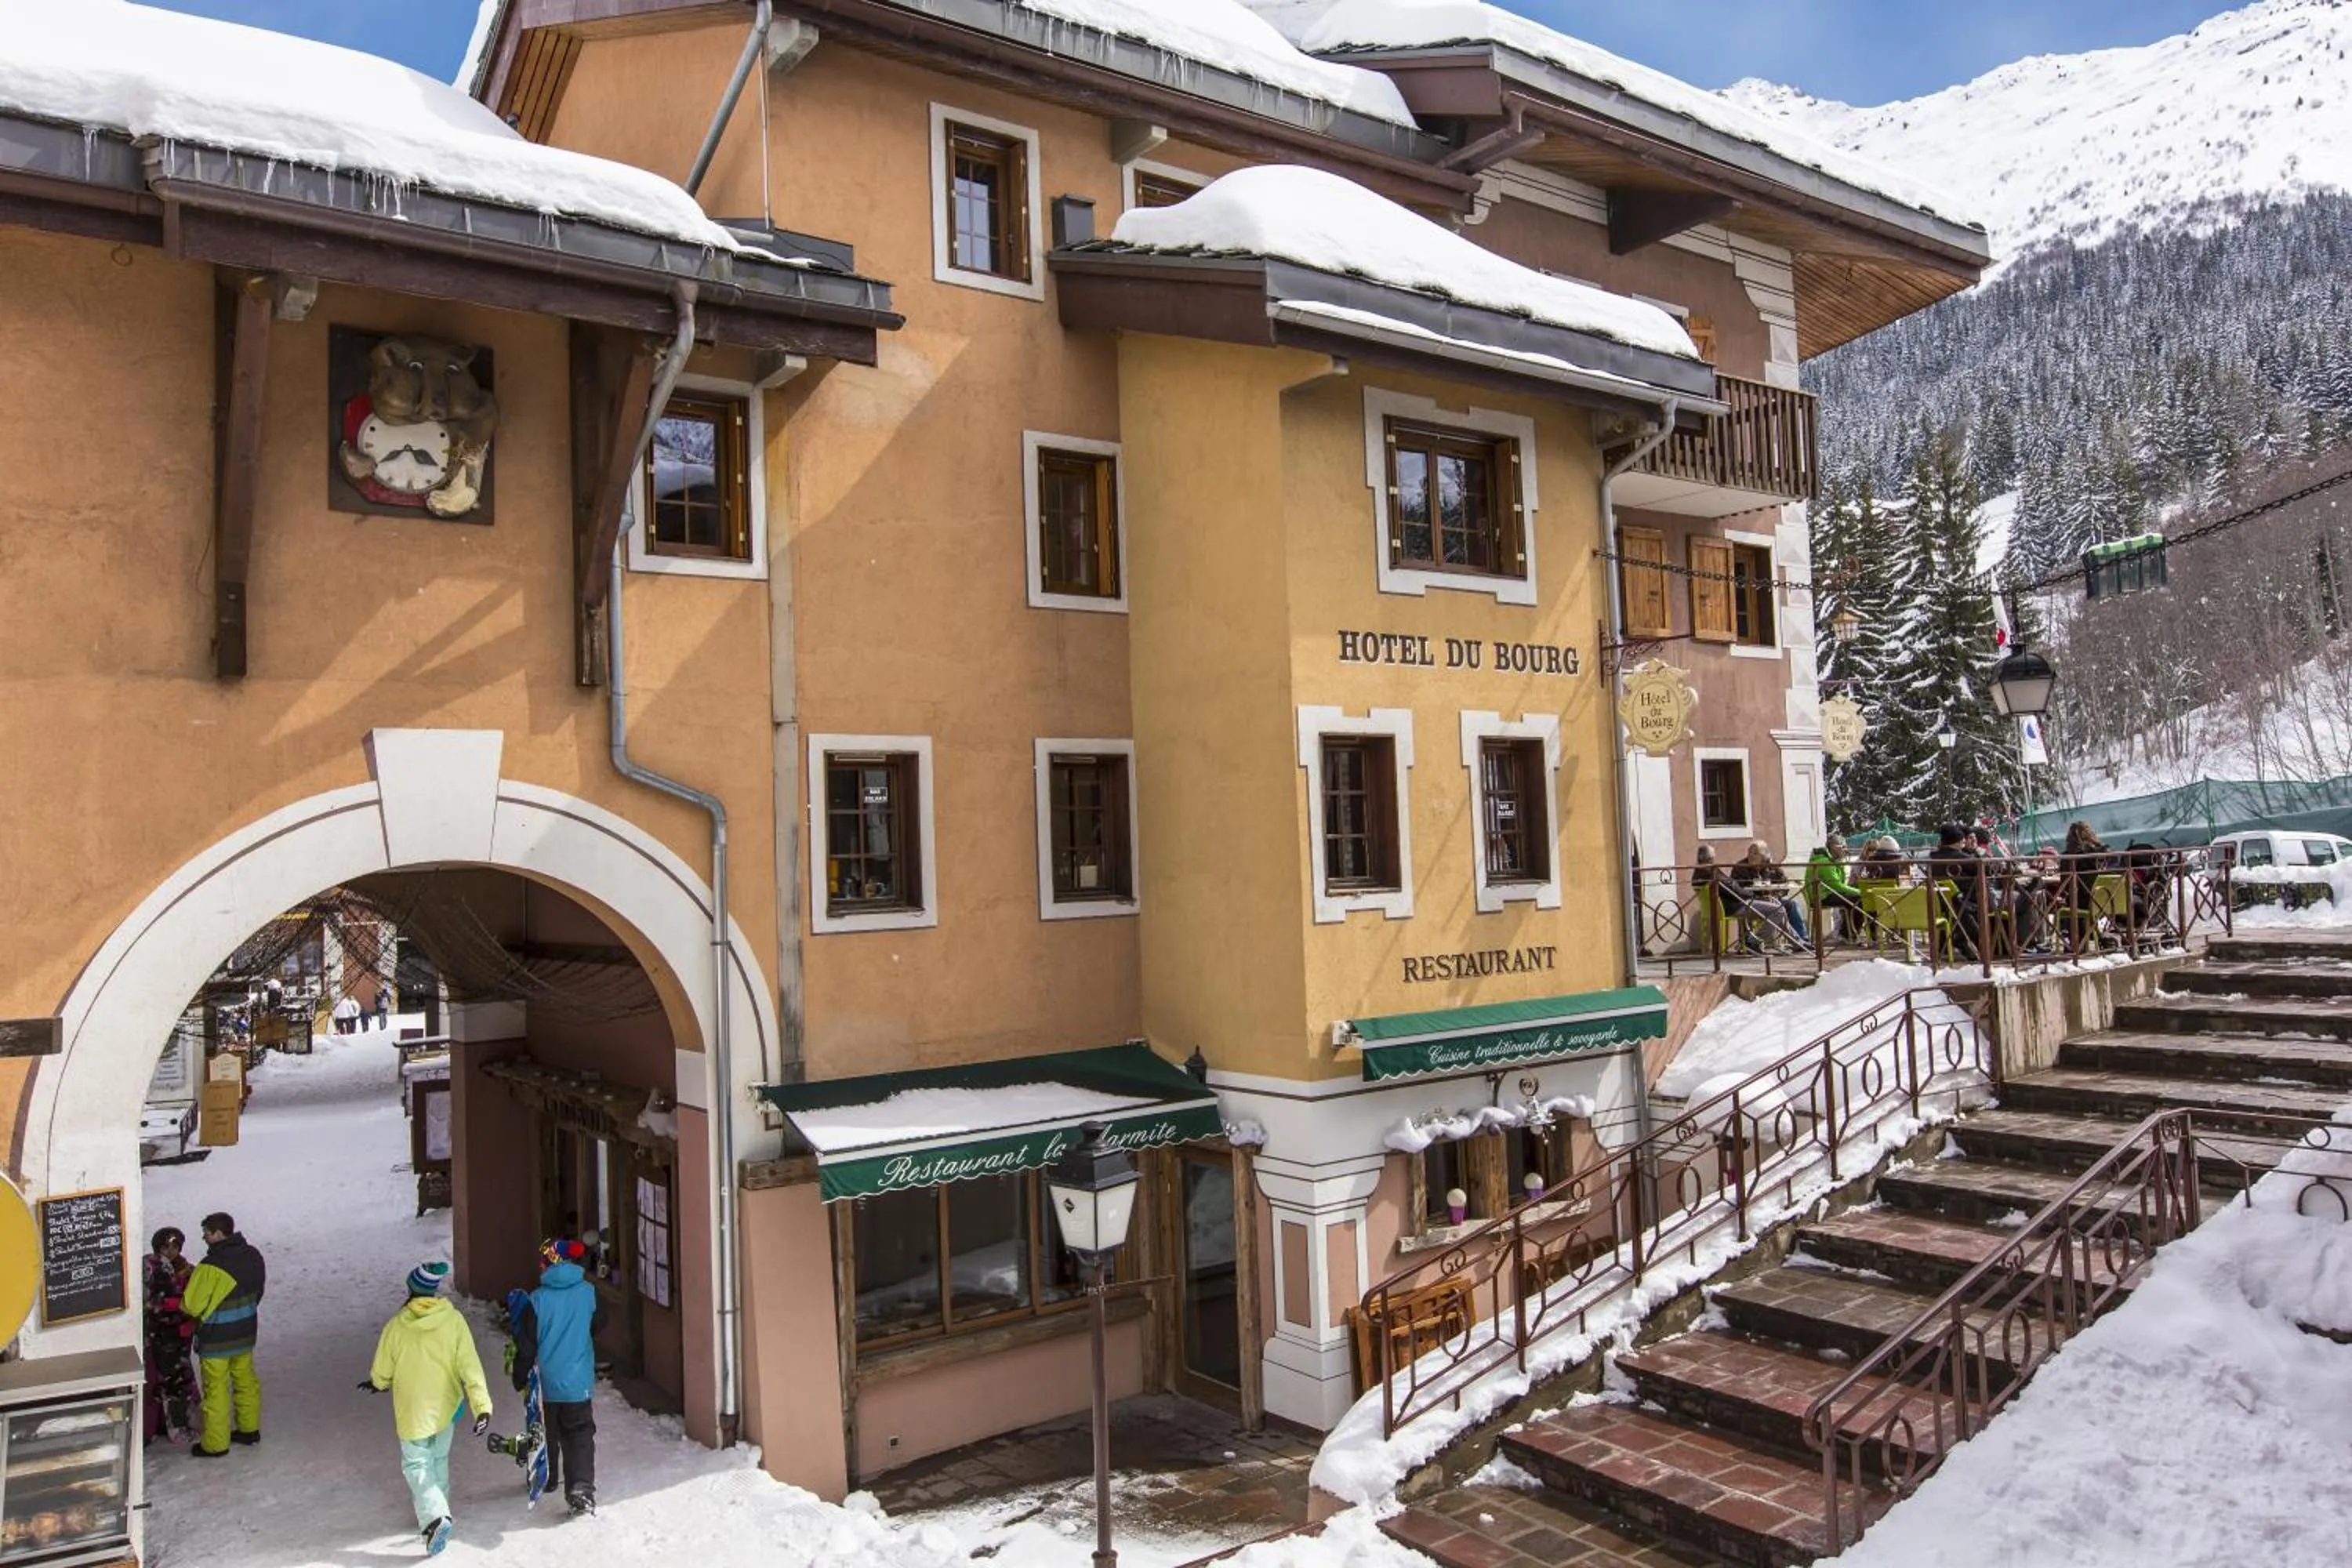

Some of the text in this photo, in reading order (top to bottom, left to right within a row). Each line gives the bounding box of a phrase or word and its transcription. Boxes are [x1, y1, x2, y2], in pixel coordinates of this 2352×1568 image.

[1338, 630, 1580, 676] HOTEL DU BOURG
[1640, 716, 1674, 730] Bourg
[1650, 706, 1662, 717] du
[1402, 946, 1556, 983] RESTAURANT
[1428, 1045, 1471, 1064] Cuisine
[1475, 1031, 1550, 1059] traditionnelle
[1567, 1024, 1618, 1047] savoyarde
[878, 1122, 1177, 1186] Restaurant la armite
